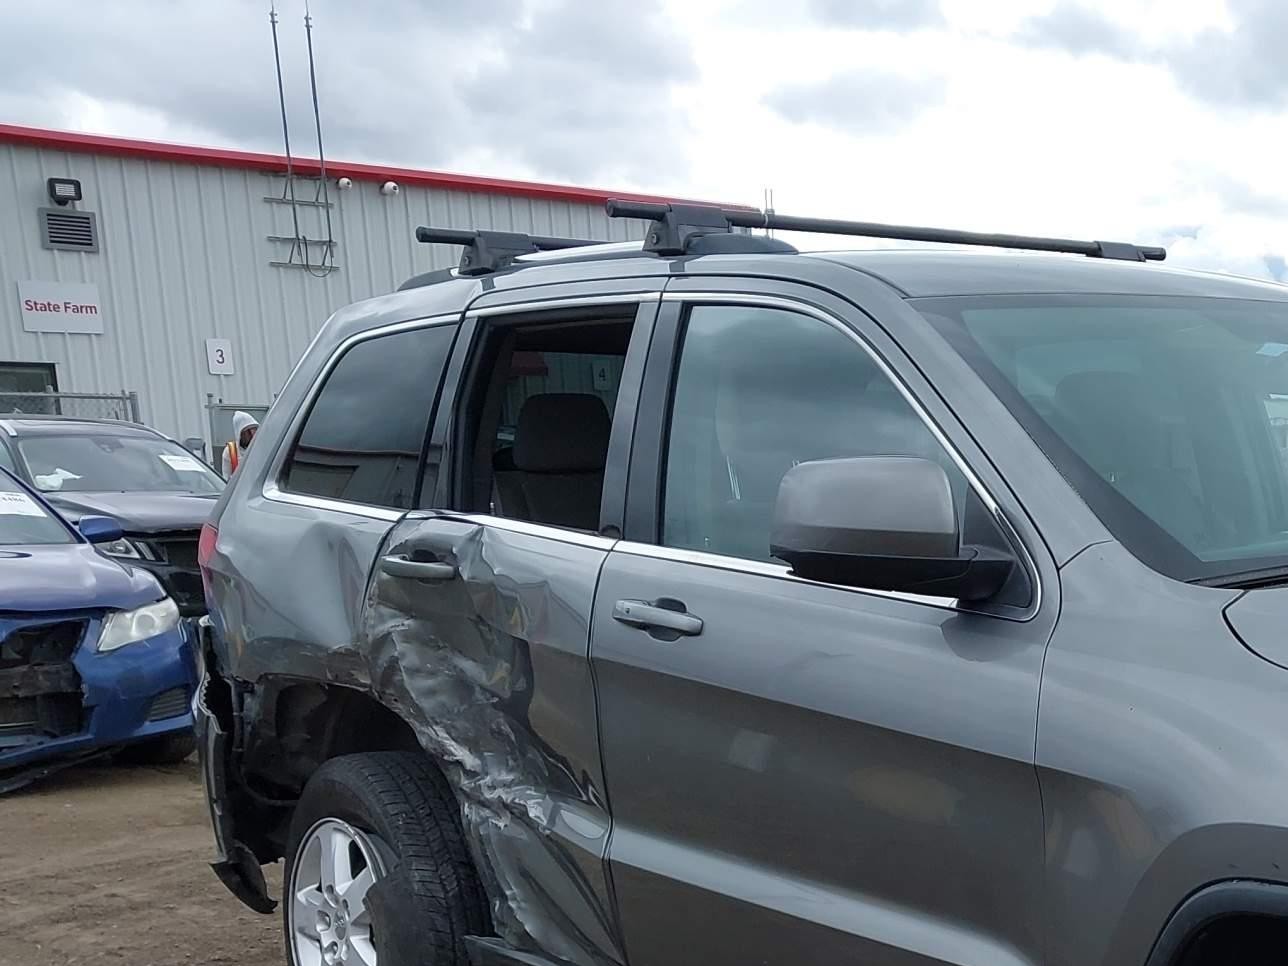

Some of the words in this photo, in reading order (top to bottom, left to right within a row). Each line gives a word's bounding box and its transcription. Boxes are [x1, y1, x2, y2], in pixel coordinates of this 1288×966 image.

[24, 299, 61, 313] State
[63, 301, 98, 315] Farm
[215, 348, 225, 364] 3
[599, 367, 606, 381] 4
